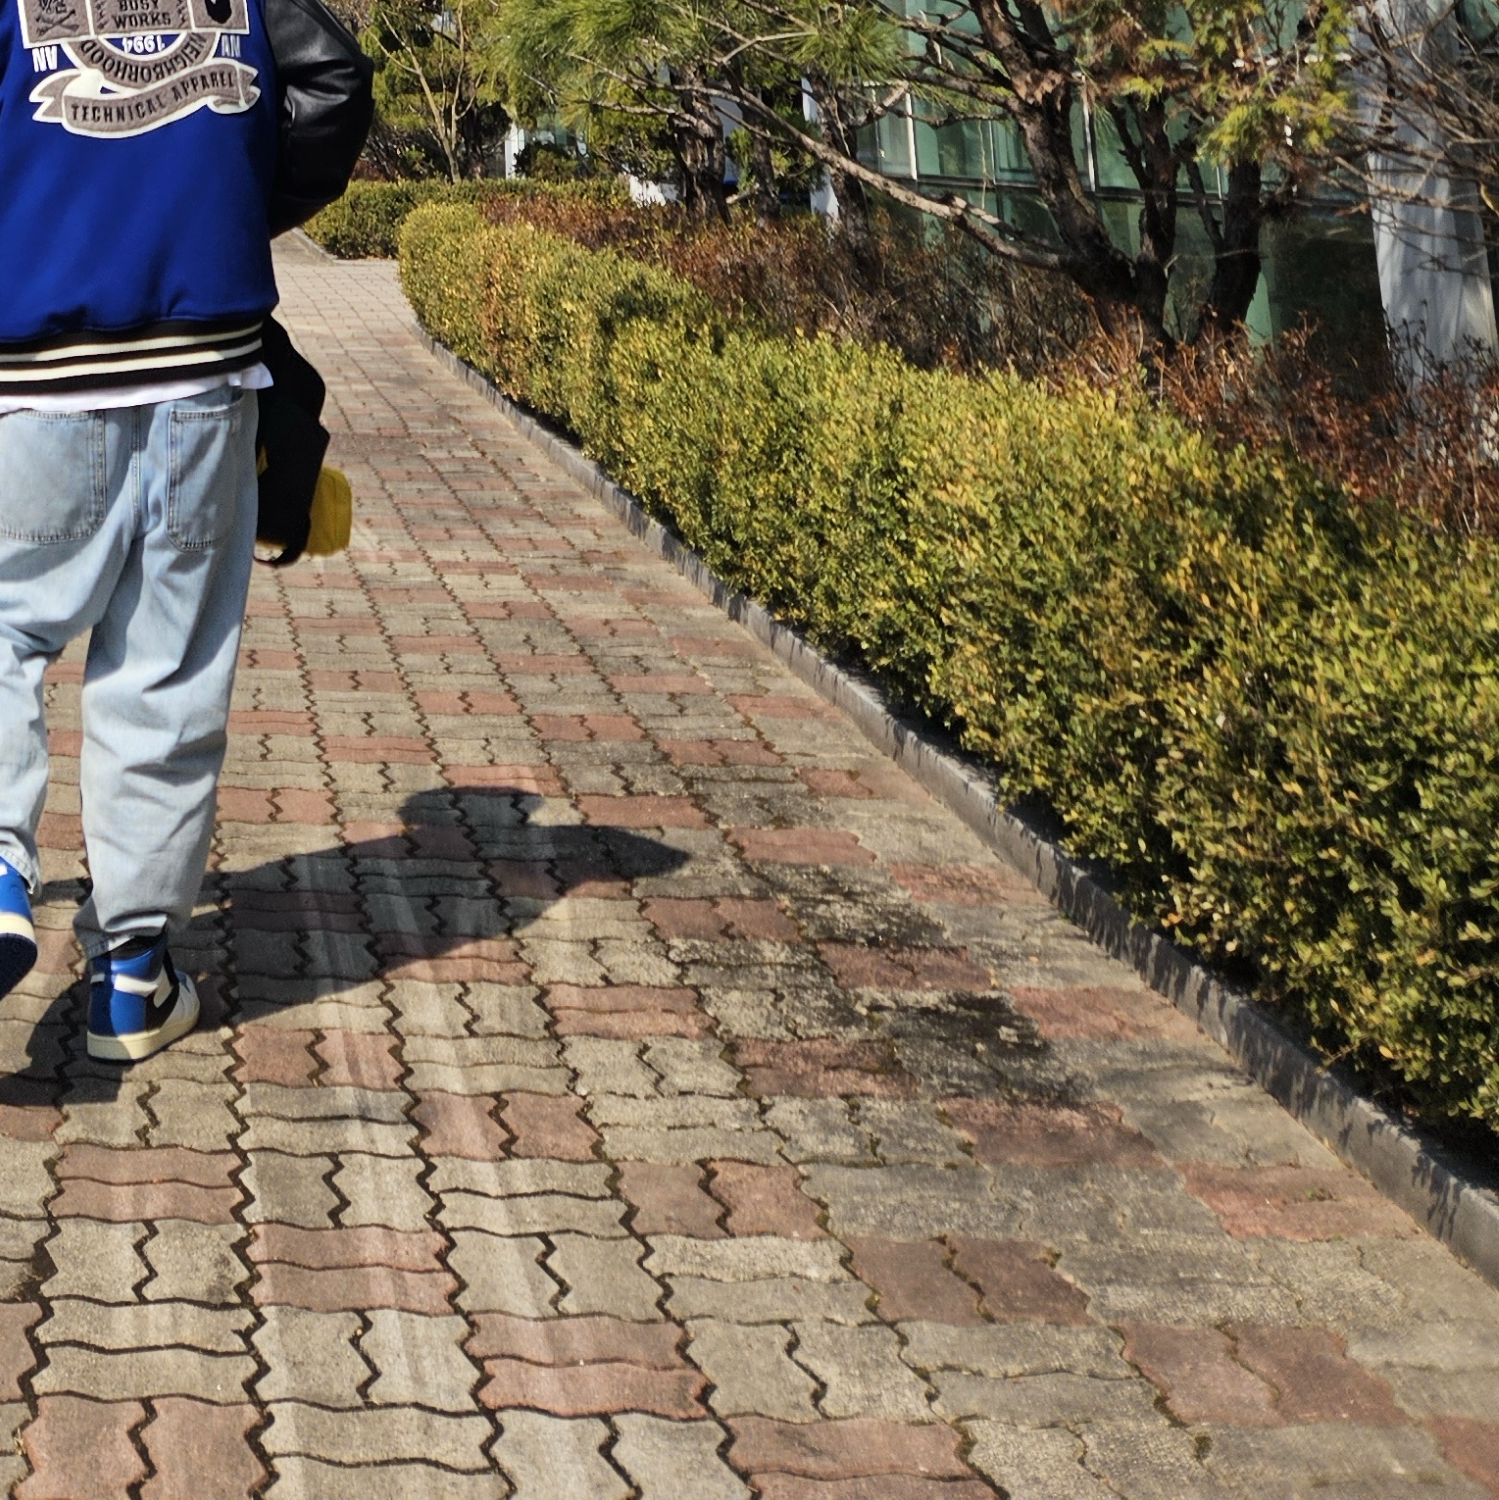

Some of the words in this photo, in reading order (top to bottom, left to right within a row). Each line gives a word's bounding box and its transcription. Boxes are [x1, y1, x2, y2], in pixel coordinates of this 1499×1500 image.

[111, 11, 172, 29] WORKS
[80, 32, 206, 83] NEIGHBORHOOD
[71, 94, 166, 123] TECHNICAL
[171, 71, 235, 102] APPAREL
